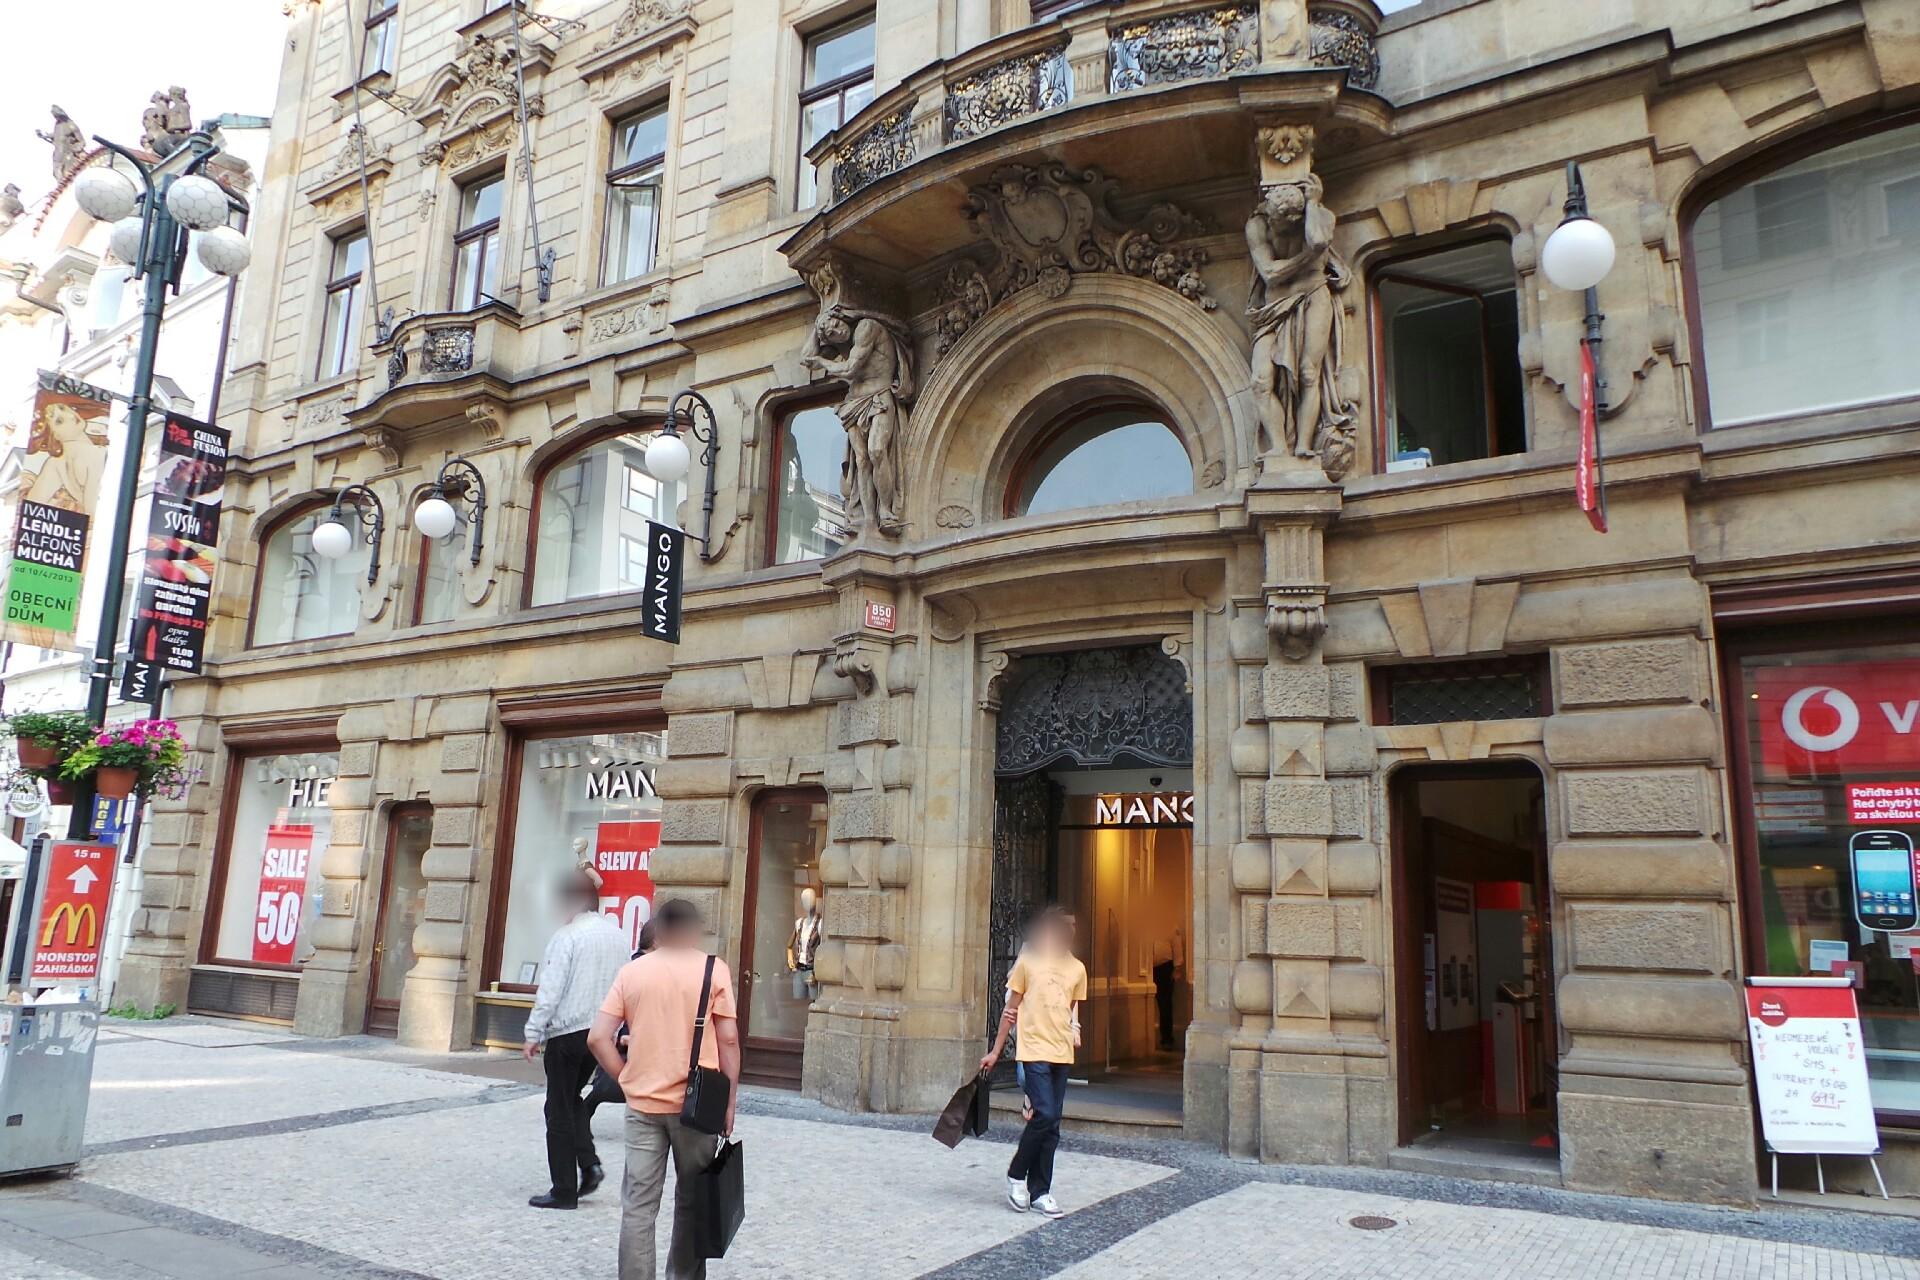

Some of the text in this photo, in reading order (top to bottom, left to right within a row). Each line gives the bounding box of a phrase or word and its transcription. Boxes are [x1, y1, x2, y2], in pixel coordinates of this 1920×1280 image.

[194, 430, 222, 446] CHINA
[193, 441, 226, 458] FUSION
[23, 503, 59, 522] IVAN
[21, 517, 81, 541] LENDL:
[19, 532, 82, 555] ALFONS
[17, 545, 75, 568] MUCHA
[654, 533, 672, 634] MANGO
[11, 590, 74, 611] OBECNÍ
[8, 604, 44, 623] DŮM
[872, 604, 891, 617] 850
[168, 627, 189, 636] open
[1853, 799, 1875, 808] Red
[1876, 798, 1913, 809] chytrý
[95, 799, 110, 829] NGE
[1854, 811, 1868, 819] za
[1869, 809, 1913, 819] skvělou
[73, 849, 101, 859] 15 m
[263, 848, 309, 878] SALE
[599, 848, 655, 871] SLEVY A
[257, 891, 300, 945] 50
[36, 952, 97, 962] NONSTOP
[34, 962, 94, 974] ZAHRÁDKA
[1802, 1058, 1825, 1070] SMS
